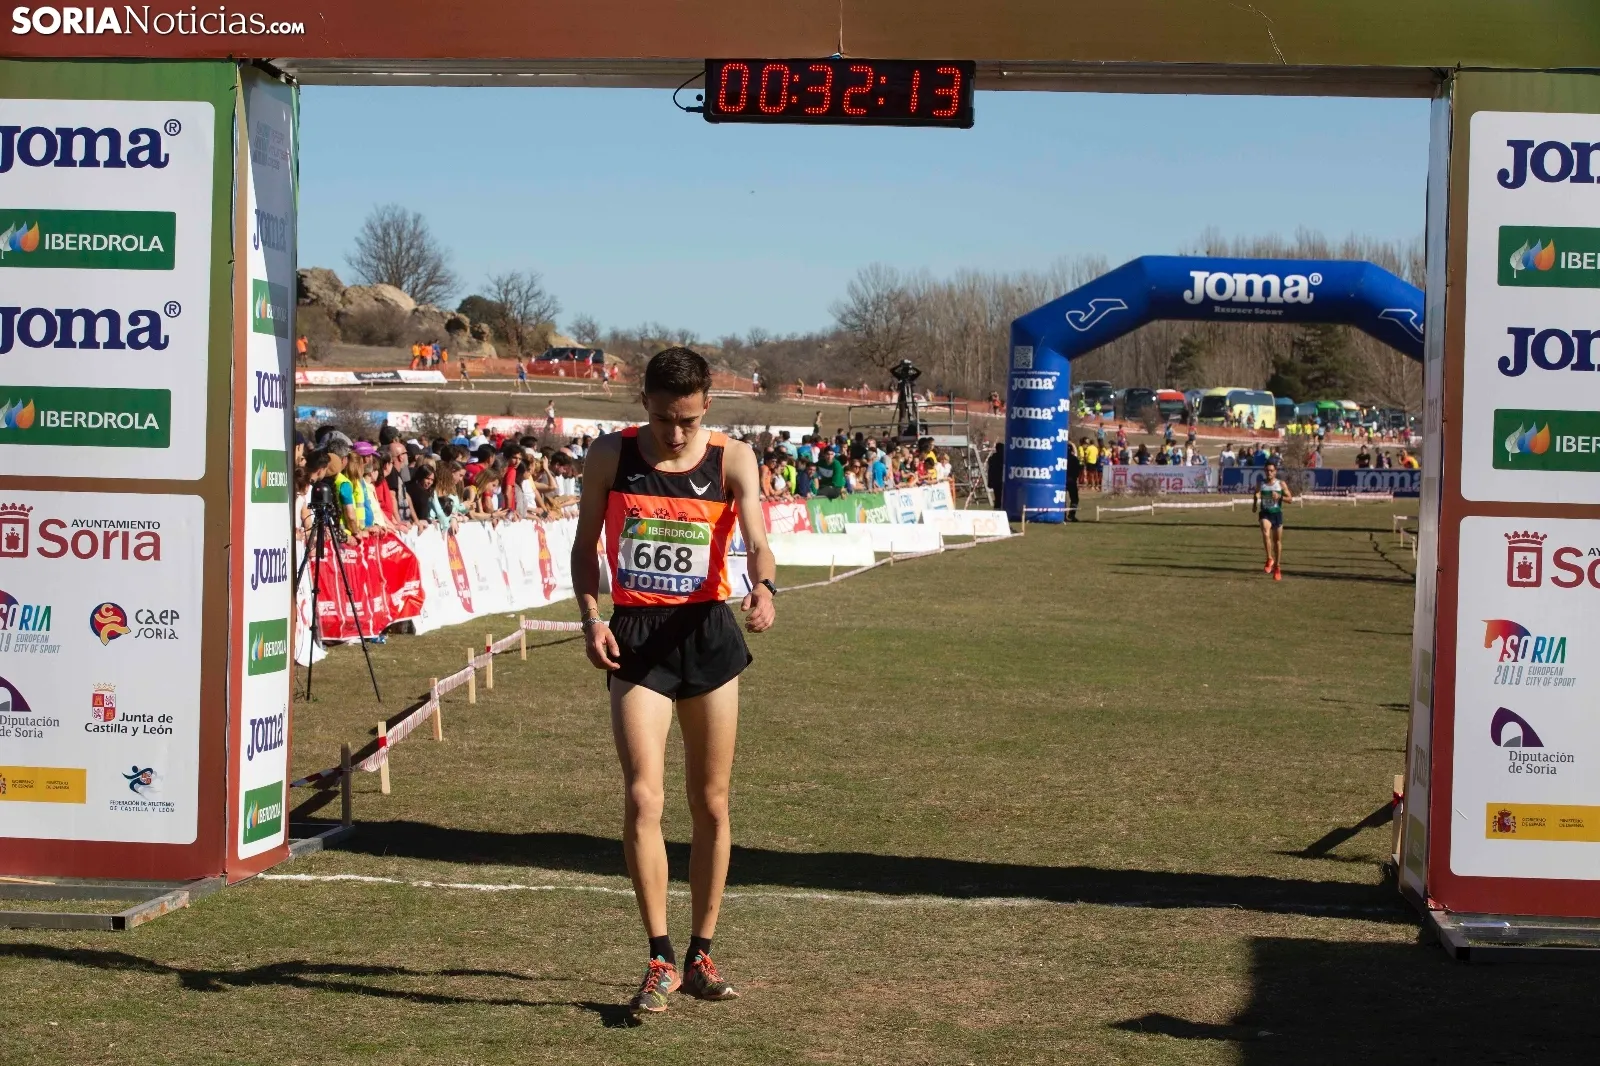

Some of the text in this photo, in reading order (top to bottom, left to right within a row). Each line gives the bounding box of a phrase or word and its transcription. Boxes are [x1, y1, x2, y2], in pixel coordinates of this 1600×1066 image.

[718, 63, 962, 117] 00:32:13
[44, 233, 165, 253] IBERDROLA
[40, 410, 160, 430] IBERDROLA
[71, 518, 160, 530] AYUNTAMIENTO
[37, 518, 161, 562] Soria
[648, 526, 705, 540] IBERDROLA
[633, 542, 693, 574] 668
[16, 633, 49, 644] EUROPEAN
[14, 643, 61, 654] CITY OF SPORT
[1527, 666, 1564, 676] EUROPEAN
[1525, 676, 1577, 688] CITY OF SPORT
[0, 714, 60, 729] Diputación
[119, 712, 174, 724] Junta de
[0, 726, 43, 739] de Soria
[84, 722, 173, 737] Castilla y León
[1508, 750, 1575, 764] Diputación
[1508, 762, 1558, 776] de Soria
